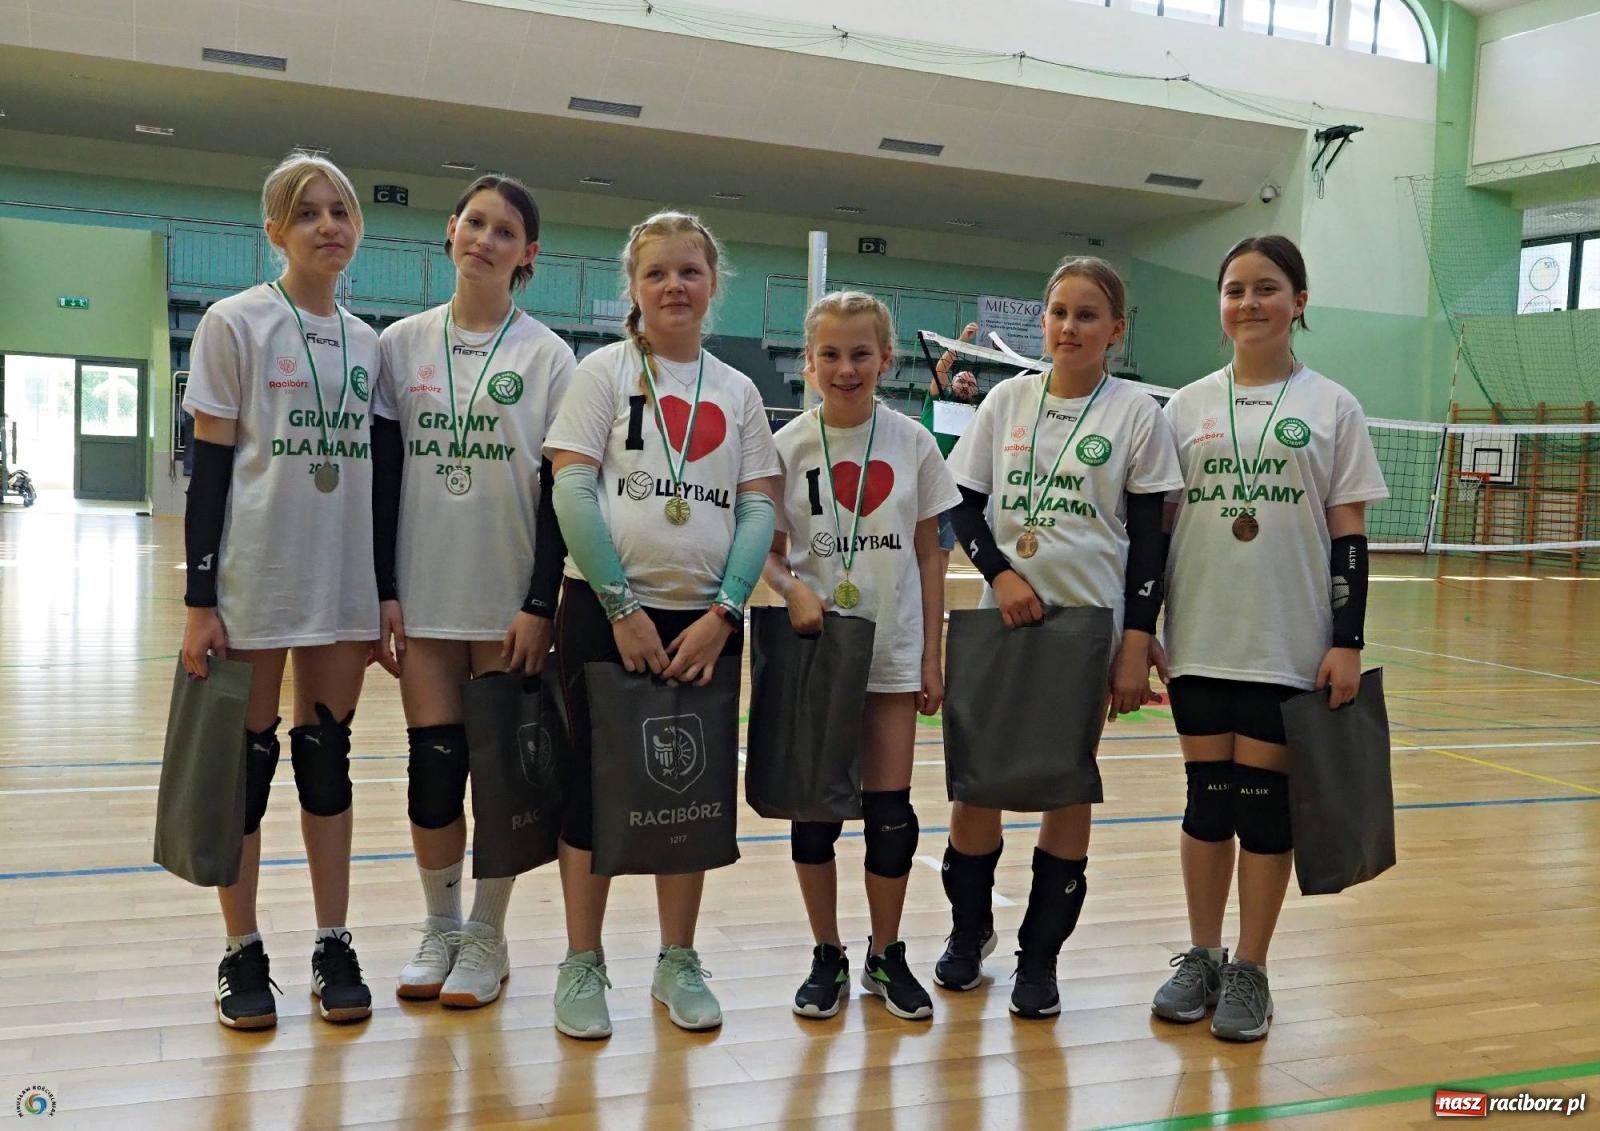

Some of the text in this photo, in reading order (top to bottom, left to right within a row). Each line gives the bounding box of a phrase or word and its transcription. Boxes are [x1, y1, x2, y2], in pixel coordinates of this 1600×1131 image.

[985, 299, 1041, 316] MIESZKO
[288, 409, 365, 430] GRAMY
[418, 411, 500, 432] GRAMY
[625, 394, 647, 451] I
[271, 438, 371, 459] DLA MAM
[447, 441, 516, 462] MAMY
[308, 463, 340, 475] 203
[1203, 457, 1288, 475] GRAMY
[806, 467, 823, 515] I
[1187, 484, 1305, 505] DLA MAMY
[1001, 494, 1029, 511] LA
[1220, 506, 1257, 518] 2023
[1024, 516, 1056, 528] 2023
[629, 801, 723, 827] RACIBÓRZ
[669, 834, 688, 845] 1217
